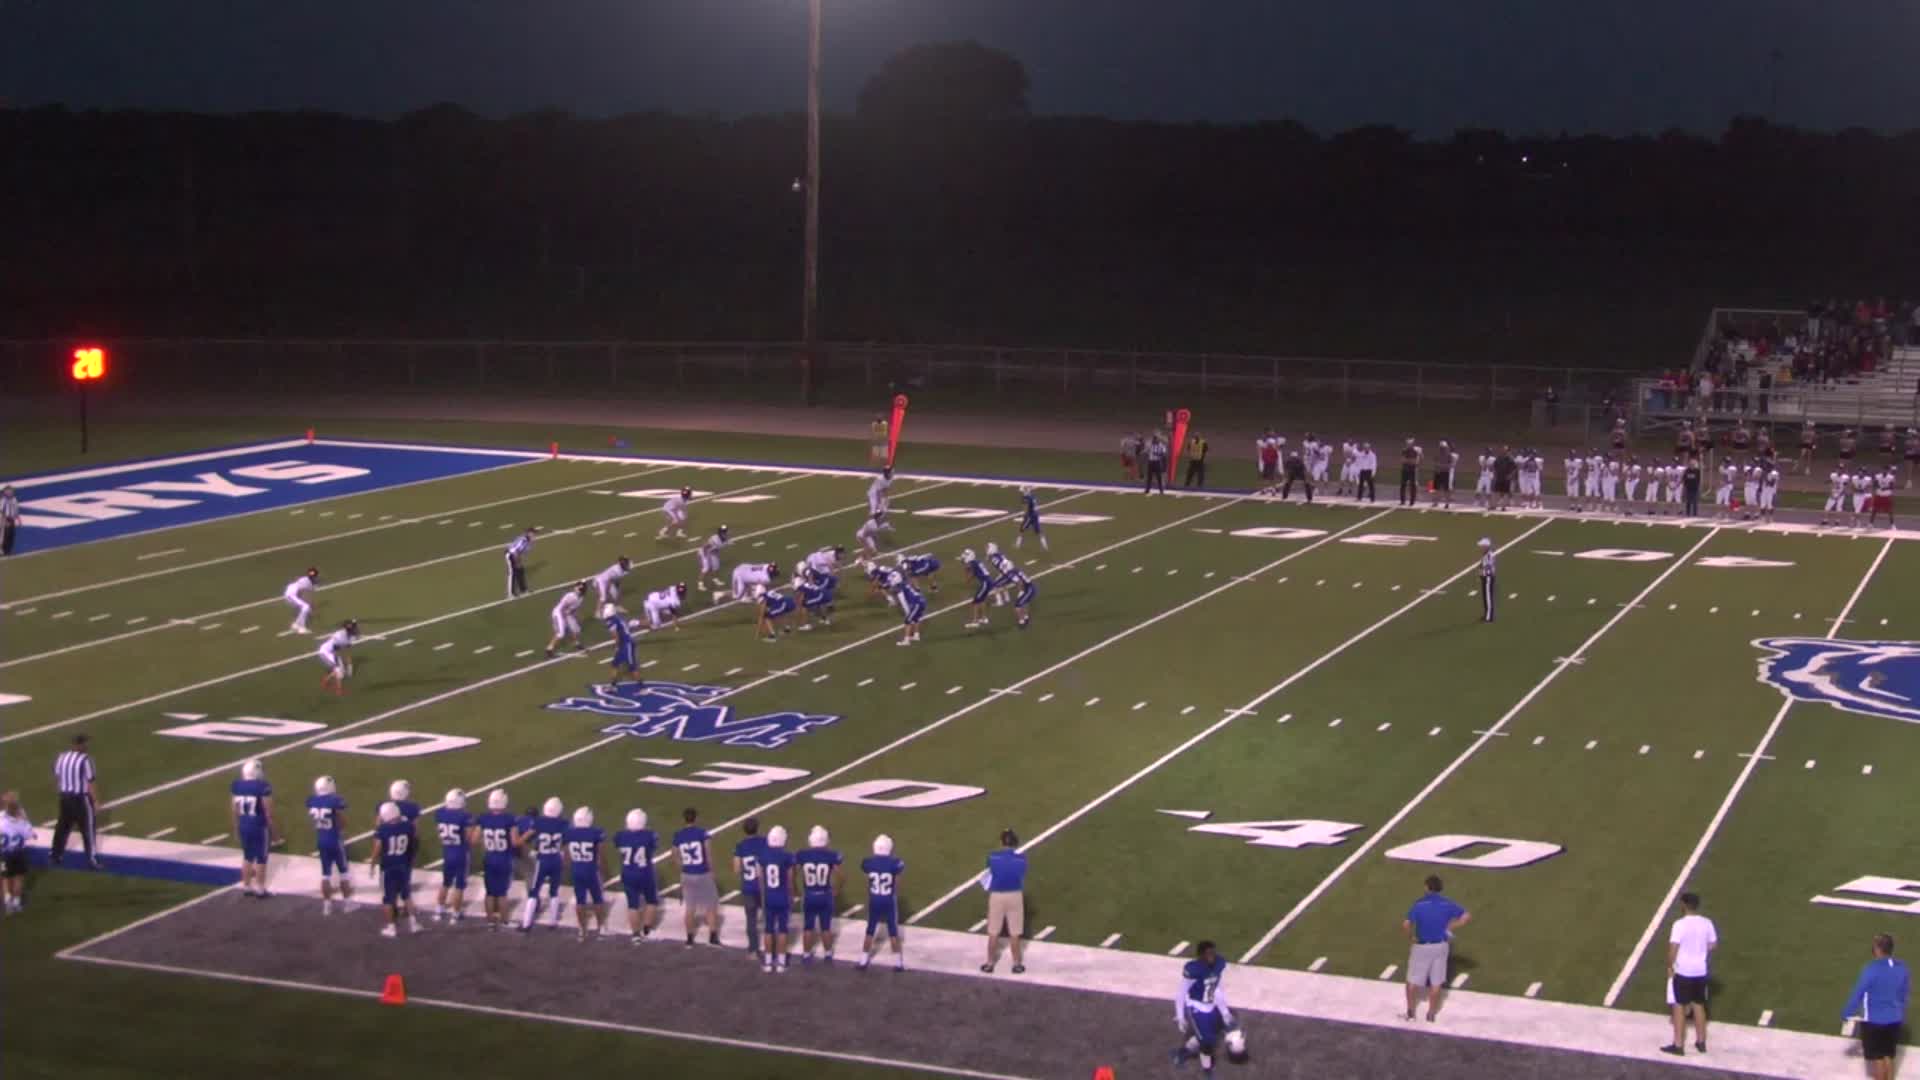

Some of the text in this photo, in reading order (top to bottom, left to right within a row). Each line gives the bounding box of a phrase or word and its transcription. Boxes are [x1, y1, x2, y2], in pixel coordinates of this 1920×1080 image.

[233, 795, 257, 816] 77
[483, 828, 507, 852] 66
[568, 841, 594, 862] 65
[620, 846, 647, 868] 74
[766, 863, 780, 889] 8
[803, 862, 829, 887] 60
[869, 872, 893, 896] 32
